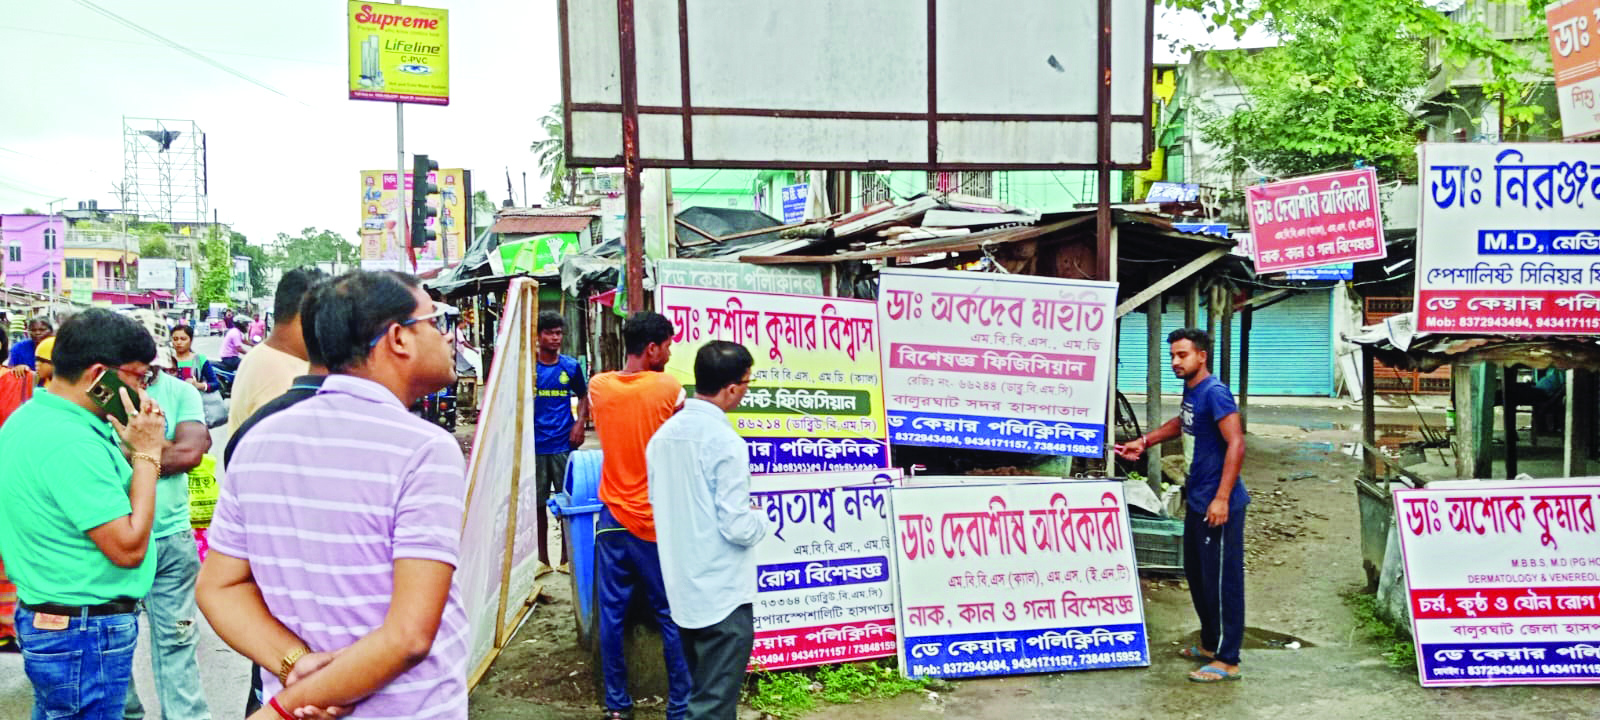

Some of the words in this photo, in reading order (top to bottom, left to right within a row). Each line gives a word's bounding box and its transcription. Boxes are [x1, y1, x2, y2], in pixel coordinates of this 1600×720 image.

[355, 4, 438, 30] Supreme
[1552, 15, 1590, 57] ডাঃ
[1430, 165, 1482, 209] ডাঃ
[1484, 232, 1544, 253] M.D,
[1552, 231, 1600, 251] মেডি
[1520, 262, 1583, 285] সিনিয়র
[886, 289, 923, 321] ডাঃ
[931, 286, 1027, 328] অর্কদেব
[1426, 296, 1460, 311] ডে
[1467, 295, 1544, 312] কেয়ার
[667, 305, 700, 343] ডাঃ
[765, 312, 817, 364] কুমার
[821, 303, 873, 361] বিশ্বাস
[1425, 317, 1456, 328] Mob:
[1459, 316, 1533, 329] 8372943494,
[897, 345, 978, 368] বিশেষজ্ঞ
[982, 350, 1088, 377] ফিজিসিয়ান
[892, 394, 961, 409] বালুরঘাট
[965, 399, 1001, 412] সদর
[1007, 401, 1091, 418] হাসপাতাল
[912, 416, 980, 434] কেয়ার
[987, 417, 1100, 441] পলিক্লিনিক
[780, 438, 881, 459] পলিক্লিনিক
[964, 436, 1032, 450] 9434171157,
[750, 488, 836, 542] মৃতাশ্ব
[899, 513, 935, 560] ডাঃ
[941, 496, 1027, 559] দেবাশীষ
[1029, 491, 1124, 554] অধিকারী
[1403, 498, 1442, 536] ডাঃ
[1445, 495, 1526, 535] অশোক
[1530, 494, 1596, 550] কুমার
[758, 569, 800, 589] রোগ
[804, 561, 883, 584] বিশেষজ্ঞ
[1467, 573, 1537, 584] DERMATOLOGY
[1541, 573, 1548, 582] &
[846, 603, 894, 617] হাসপাতা
[907, 605, 952, 628] নাক,
[957, 602, 995, 625] কান
[1002, 601, 1017, 622] ও
[1023, 599, 1056, 621] গলা
[1062, 590, 1135, 619] বিশেষজ্ঞ
[1418, 593, 1452, 614] চর্ম,
[1456, 591, 1489, 617] কুষ্ঠ
[1494, 596, 1509, 611] ও
[1514, 589, 1552, 611] যৌন
[1555, 594, 1595, 611] রোগ
[1450, 622, 1514, 639] বালুরঘাট
[1520, 623, 1558, 636] জেলা
[791, 646, 846, 661] 9434171157
[911, 641, 943, 659] ডে
[948, 637, 1018, 656] কেয়ার
[1026, 628, 1137, 652] পলিক্লিনিক
[1434, 649, 1466, 662] ডে
[1469, 648, 1547, 662] কেয়ার
[913, 664, 941, 676] Mob:
[943, 658, 1010, 675] 8372943494,
[1012, 655, 1077, 669] 9434171157,
[1079, 650, 1141, 665] 7384815952
[1467, 665, 1534, 676] 8372943494
